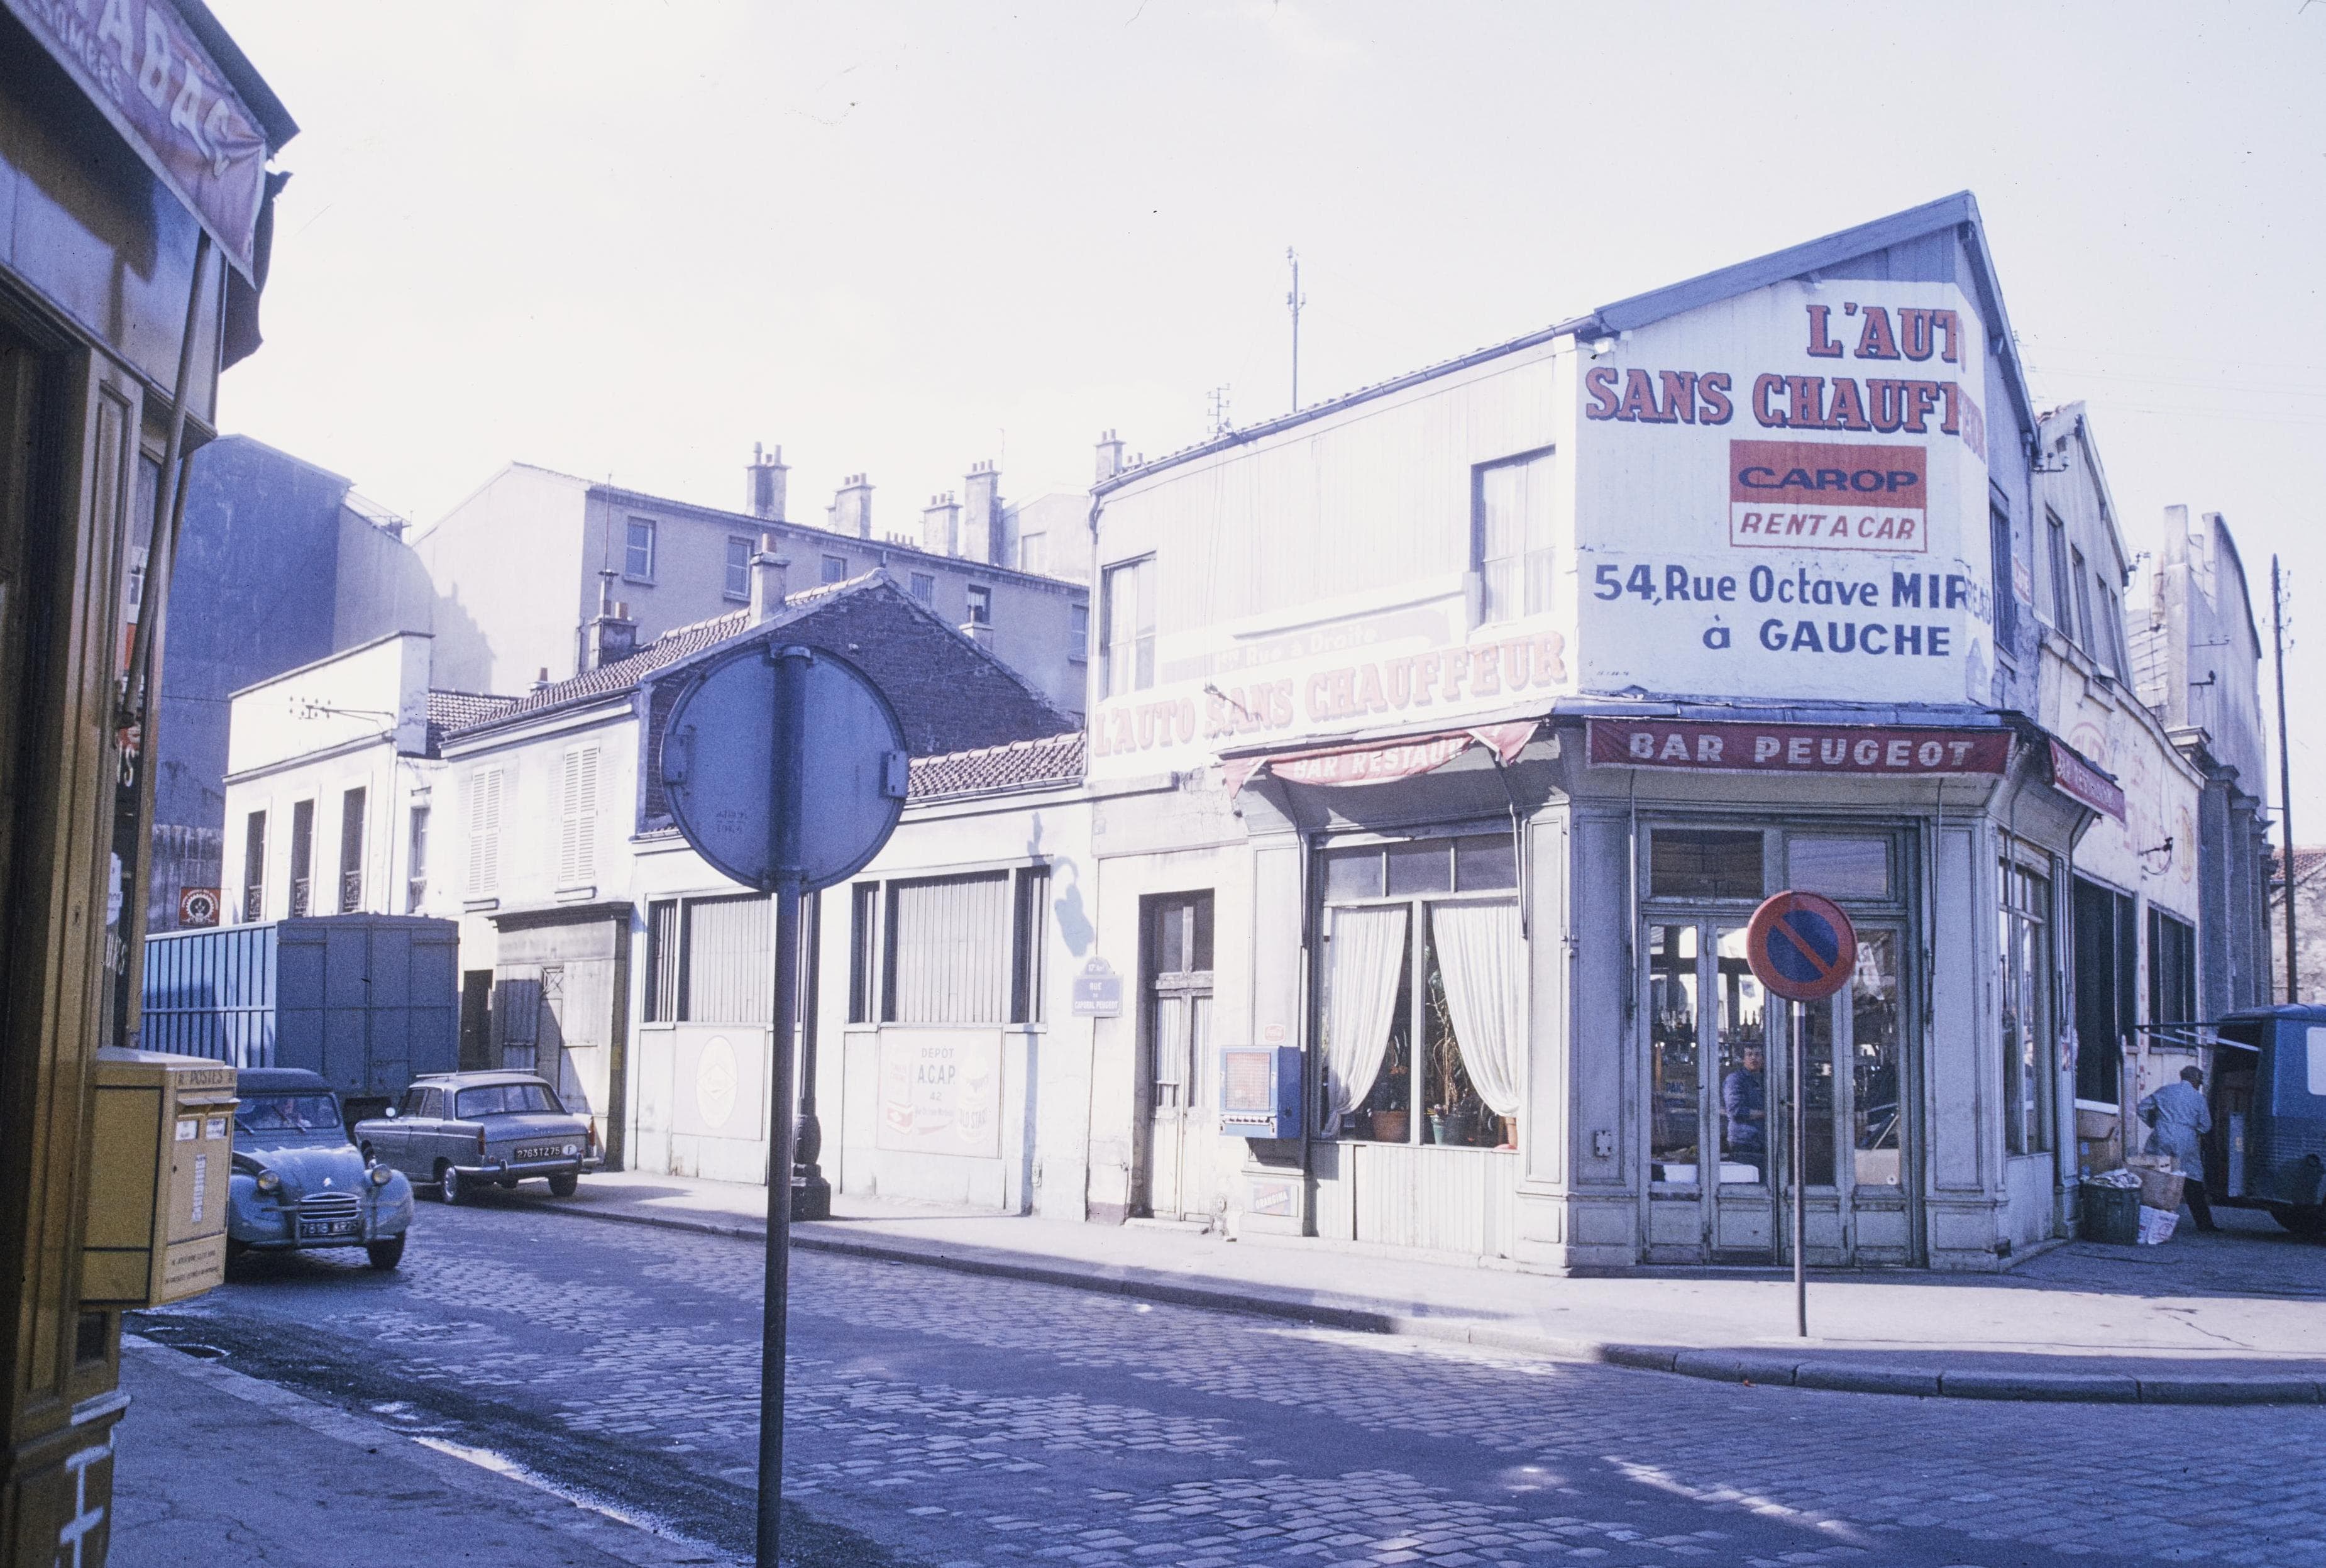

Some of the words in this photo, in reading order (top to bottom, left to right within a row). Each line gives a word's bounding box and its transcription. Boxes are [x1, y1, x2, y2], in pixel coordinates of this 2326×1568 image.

[1585, 367, 1734, 426] SANS
[1738, 467, 1919, 492] CAROP
[1740, 512, 1827, 537] RENT
[1828, 515, 1848, 538] A
[1858, 516, 1916, 541] CAR
[1749, 565, 1879, 607] Octave
[1702, 614, 1731, 650] à
[1759, 618, 1950, 657] GAUCHE
[1094, 697, 1195, 757] L'AUTO
[1204, 677, 1294, 737] SANS
[1304, 630, 1568, 723] CHAUFFEUR
[1629, 732, 1724, 762] BAR
[1754, 736, 1975, 767] PEUGEOT
[1293, 757, 1338, 778] BAR
[1089, 981, 1103, 991] RUE
[190, 1069, 223, 1085] POSTES
[929, 1091, 943, 1101] 42
[567, 1145, 573, 1155] F
[1255, 1191, 1289, 1210] ORANGINA
